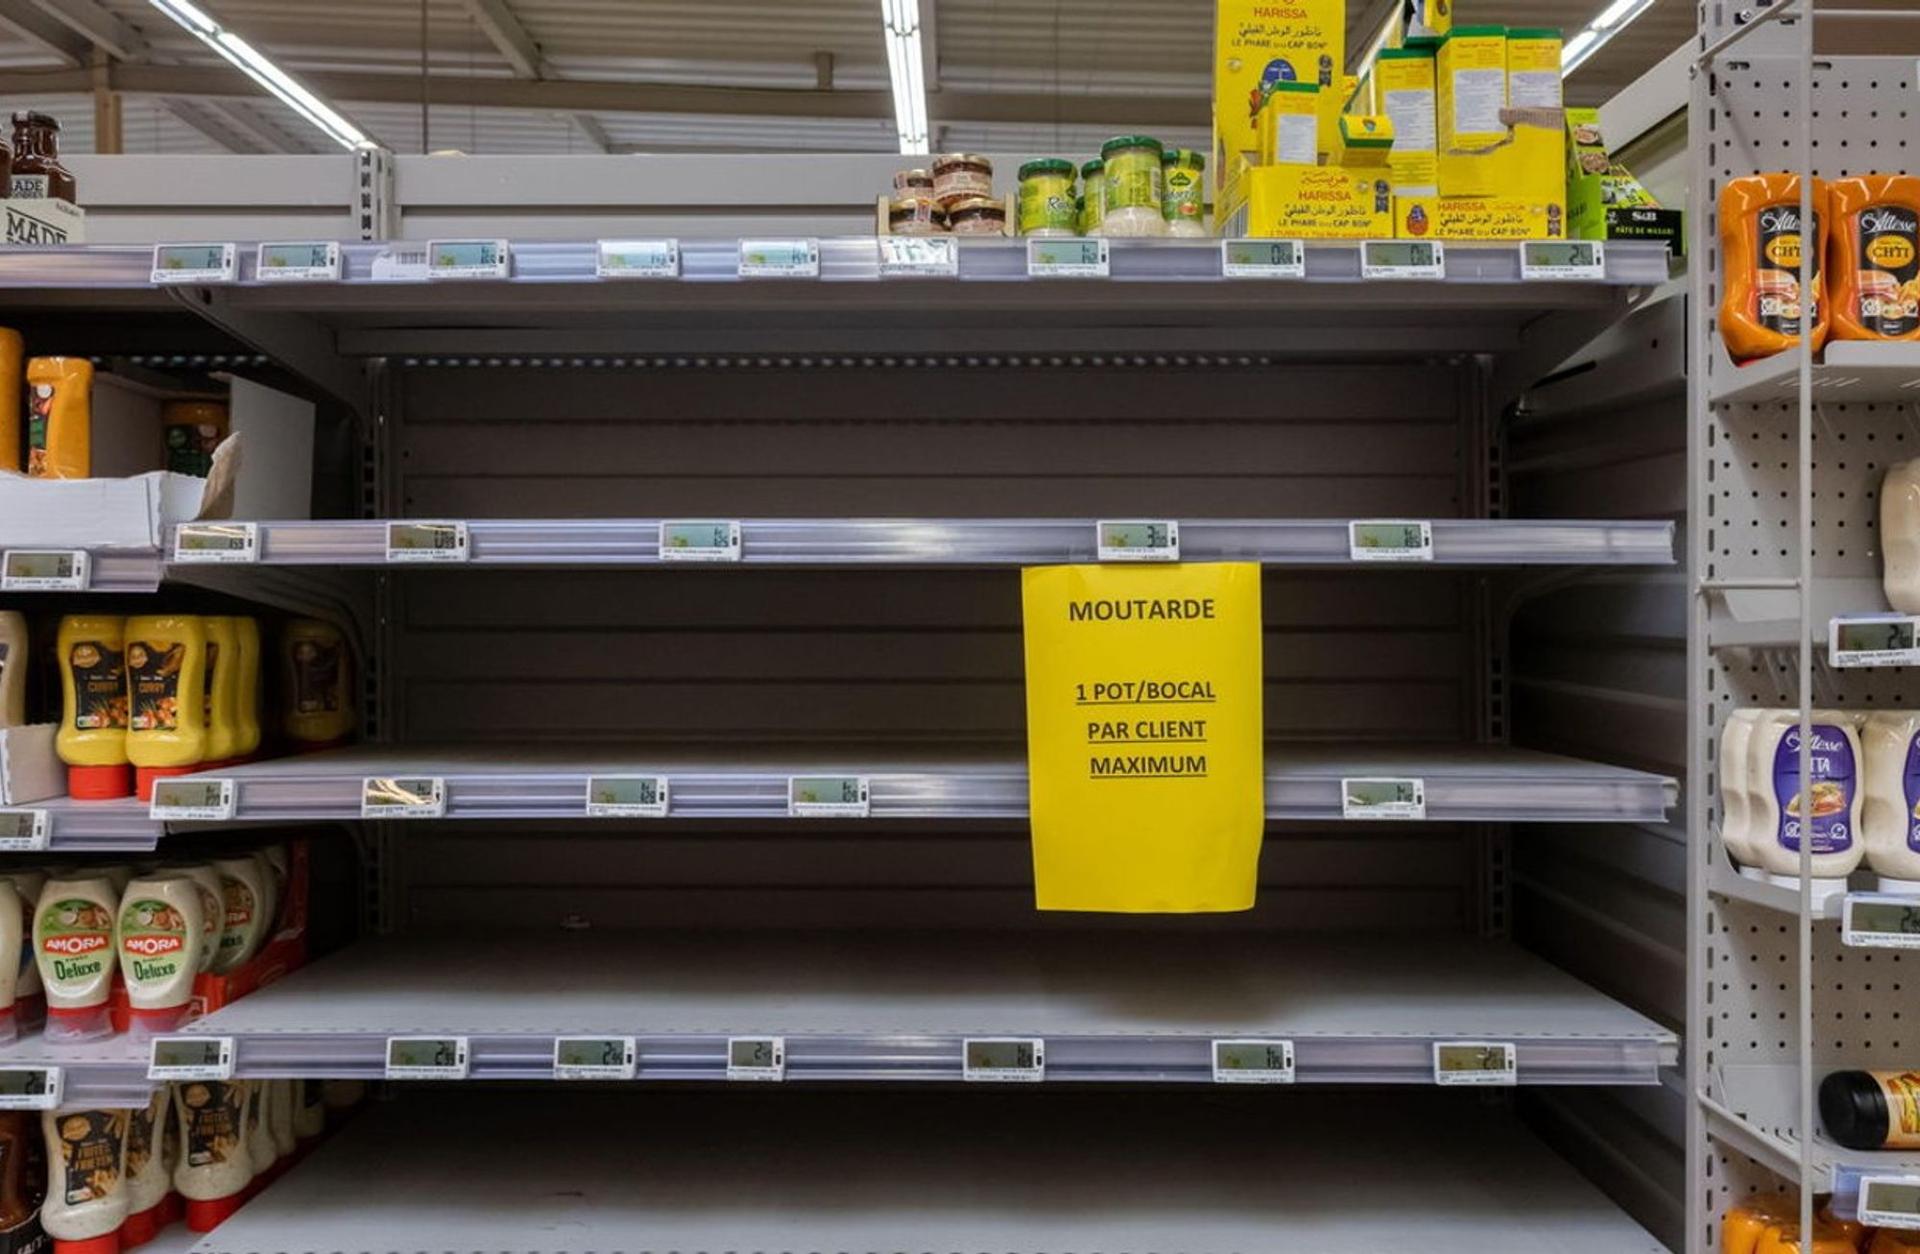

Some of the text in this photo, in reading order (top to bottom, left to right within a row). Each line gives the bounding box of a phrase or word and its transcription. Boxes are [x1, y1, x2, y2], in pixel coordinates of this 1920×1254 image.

[1254, 8, 1307, 18] HARISSA
[1232, 39, 1241, 47] LE
[13, 180, 44, 191] ADE
[1298, 190, 1351, 201] HARISSA
[1438, 201, 1486, 211] HARISSA
[1871, 247, 1909, 258] CH'TI
[1069, 599, 1215, 621] MOUTARDE
[1077, 681, 1215, 702] 1 POT/BOCAL
[1088, 720, 1206, 739] PAR CLIENT
[1090, 756, 1206, 774] MAXIMUM
[46, 937, 105, 953] AMORA
[126, 938, 178, 953] AMORA
[54, 960, 101, 981] Deluxe
[133, 960, 176, 981] Deluxe
